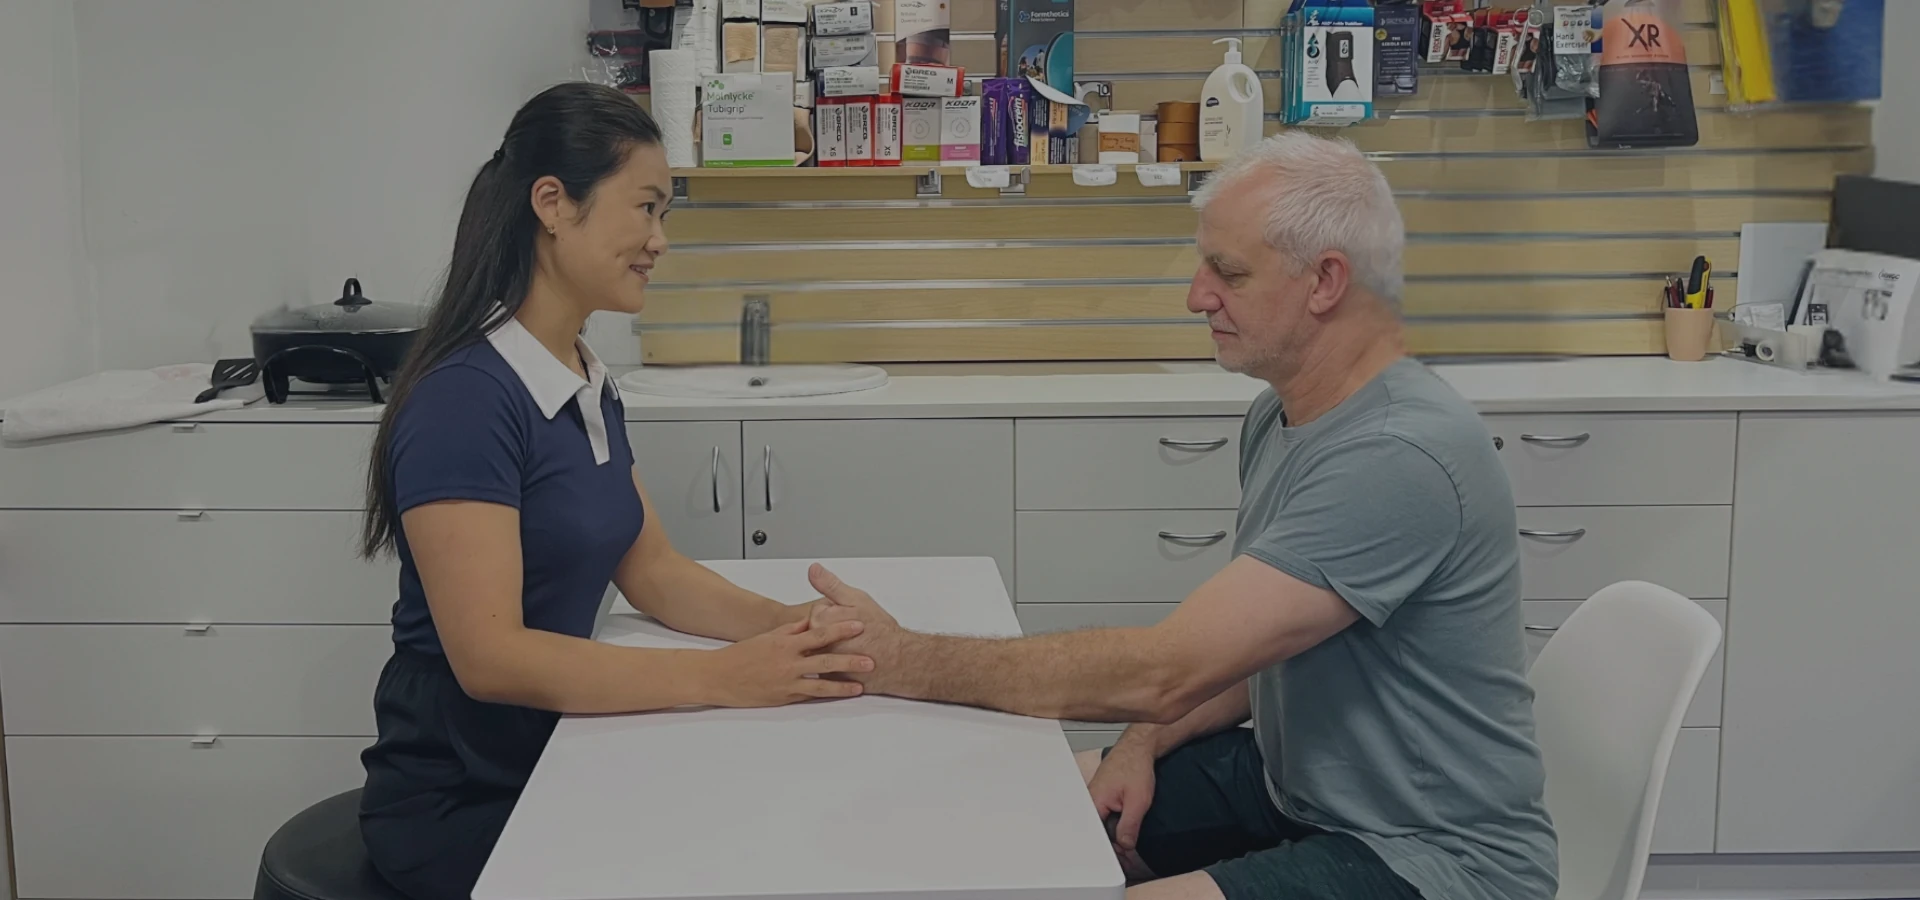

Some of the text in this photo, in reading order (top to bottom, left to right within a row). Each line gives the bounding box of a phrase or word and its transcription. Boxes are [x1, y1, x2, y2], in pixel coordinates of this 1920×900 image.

[1030, 10, 1070, 18] Formthotics
[1556, 32, 1575, 40] Hand
[1621, 18, 1661, 51] XR
[1556, 40, 1588, 49] Exerciser
[912, 68, 937, 76] BREG
[946, 77, 954, 85] M
[1096, 83, 1110, 95] 10
[708, 104, 745, 115] Tubigrip
[830, 146, 837, 157] XS
[857, 144, 863, 155] XS
[884, 145, 891, 156] XS
